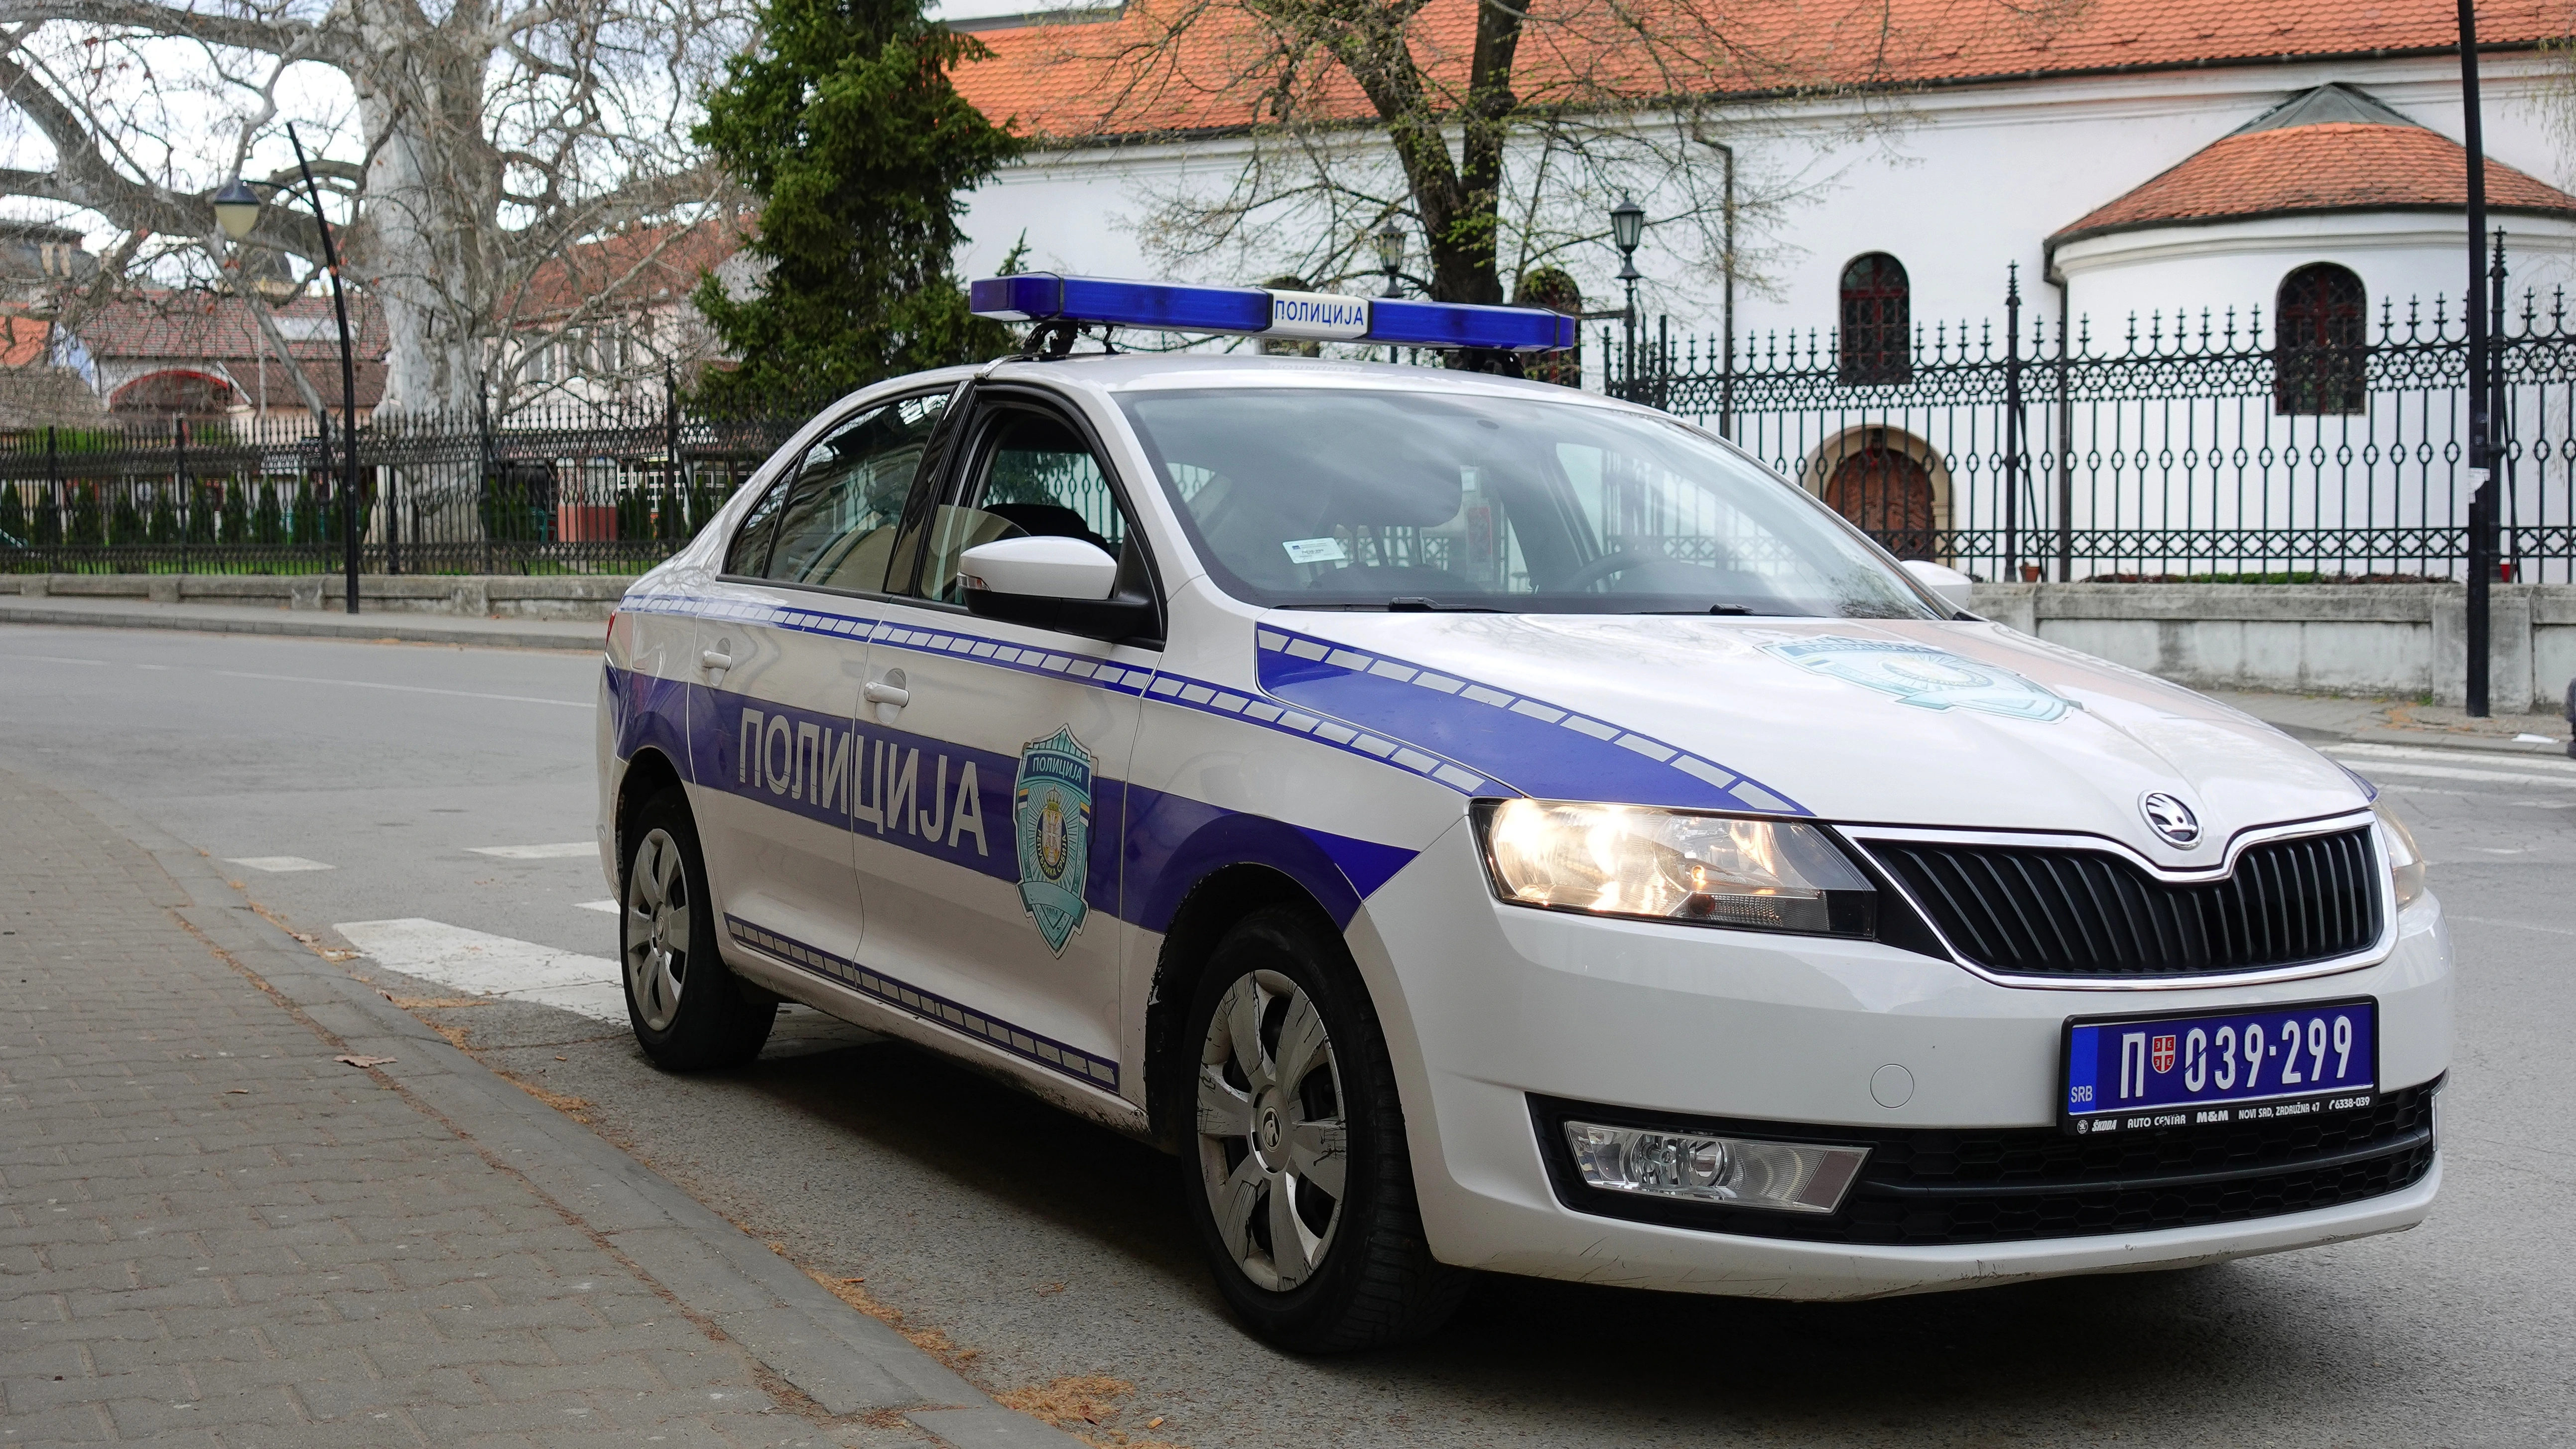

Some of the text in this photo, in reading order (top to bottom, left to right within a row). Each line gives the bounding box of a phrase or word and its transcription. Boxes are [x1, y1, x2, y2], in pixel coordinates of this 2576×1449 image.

[1275, 300, 1364, 327] ПОЛИЦИЈА
[739, 707, 989, 857] ПОЛИЦИЈА
[1032, 756, 1082, 783] ПОЛИЦИЈА
[1036, 829, 1066, 876] РЕПУБЛИКА СРБИЈА
[2070, 1085, 2093, 1103] SRB
[2092, 1119, 2117, 1132] ŠKODA
[2127, 1117, 2151, 1129] AUTO
[2196, 1110, 2229, 1123] M&M
[2238, 1108, 2256, 1120] NOVI
[2258, 1107, 2274, 1118] SAD,
[2276, 1102, 2310, 1116] ZADRUŽNA
[2312, 1102, 2320, 1112] 47
[2334, 1096, 2370, 1109] 6338-039
